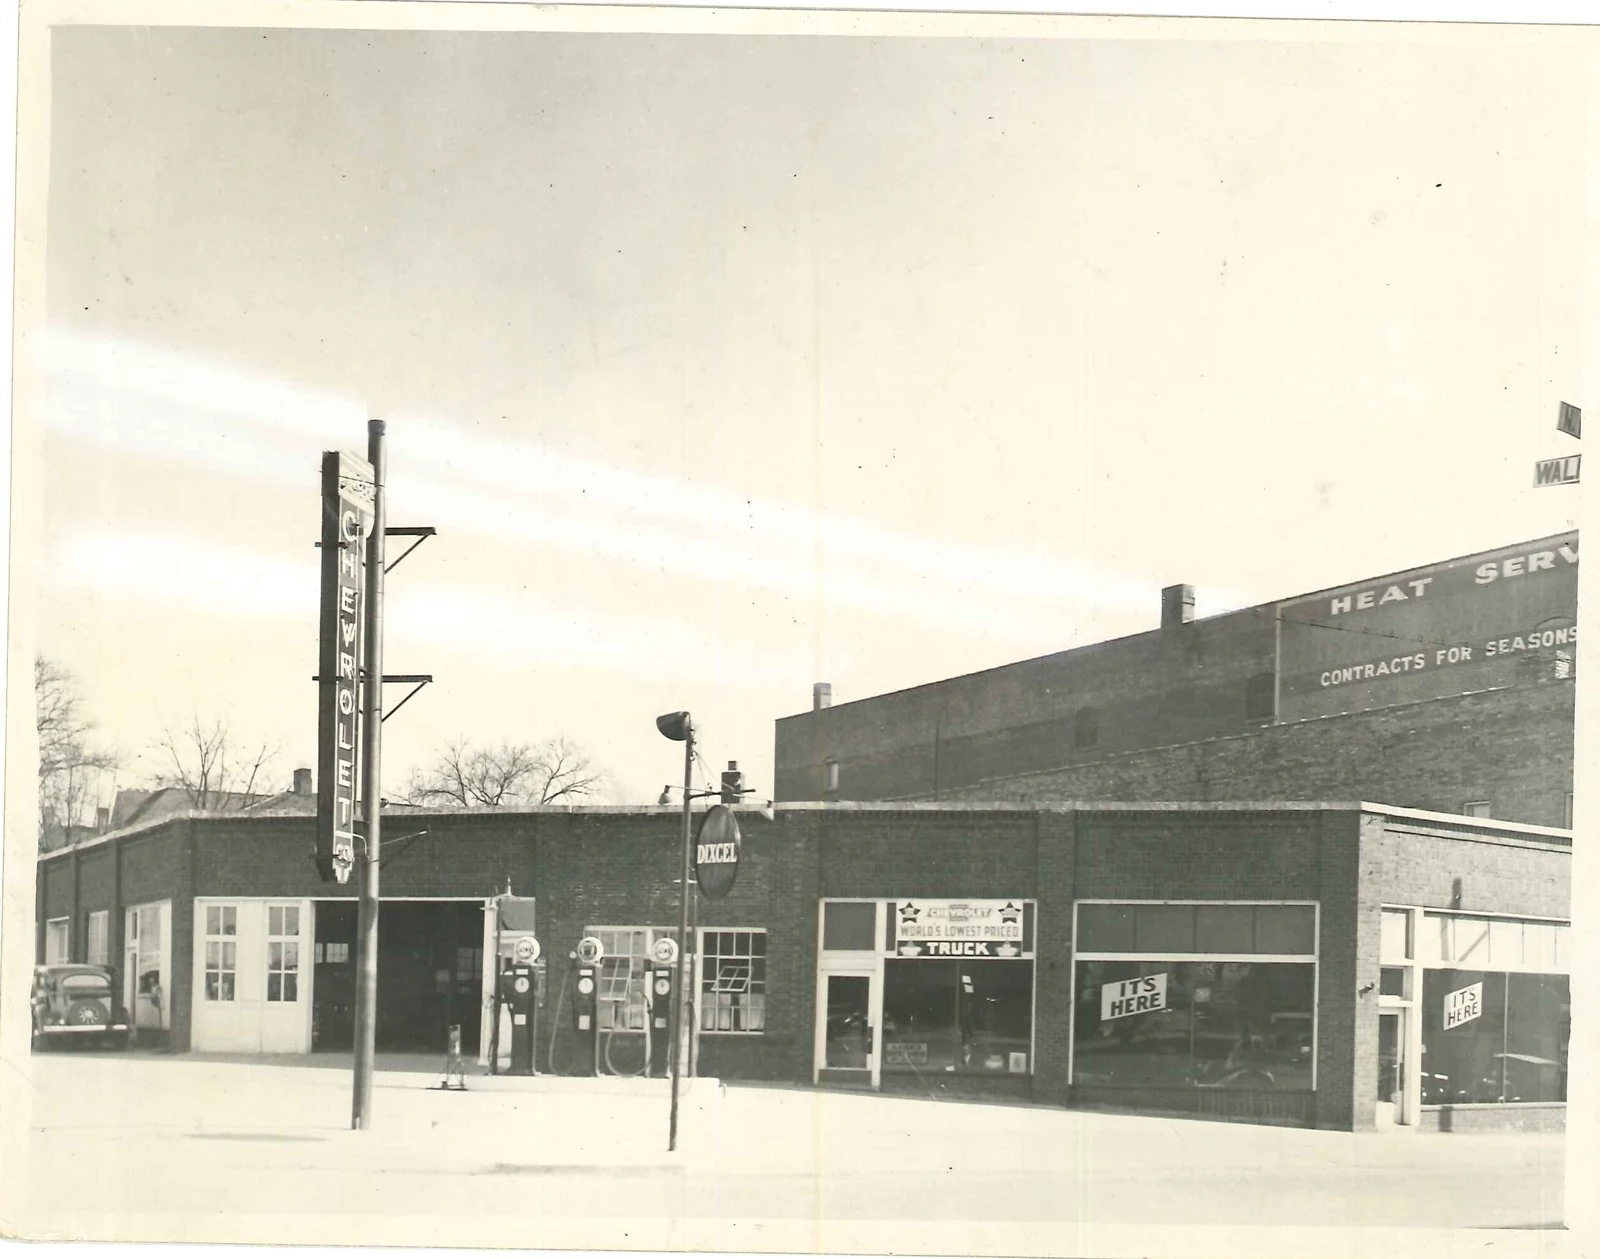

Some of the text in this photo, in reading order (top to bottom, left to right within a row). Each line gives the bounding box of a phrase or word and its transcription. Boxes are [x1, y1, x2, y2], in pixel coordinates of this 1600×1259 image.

[1331, 577, 1433, 615] HEAT
[1320, 626, 1577, 687] CONTRACTS FOR SEASONS
[339, 510, 358, 827] CHEVROLET
[696, 842, 737, 864] DIXCEL
[929, 907, 991, 918] CHEVROLET
[900, 924, 1019, 938] WORLD'S LOWEST PRICED
[926, 942, 990, 955] TRUCK
[1111, 992, 1161, 1016] HERE
[1448, 1002, 1478, 1025] HERE
